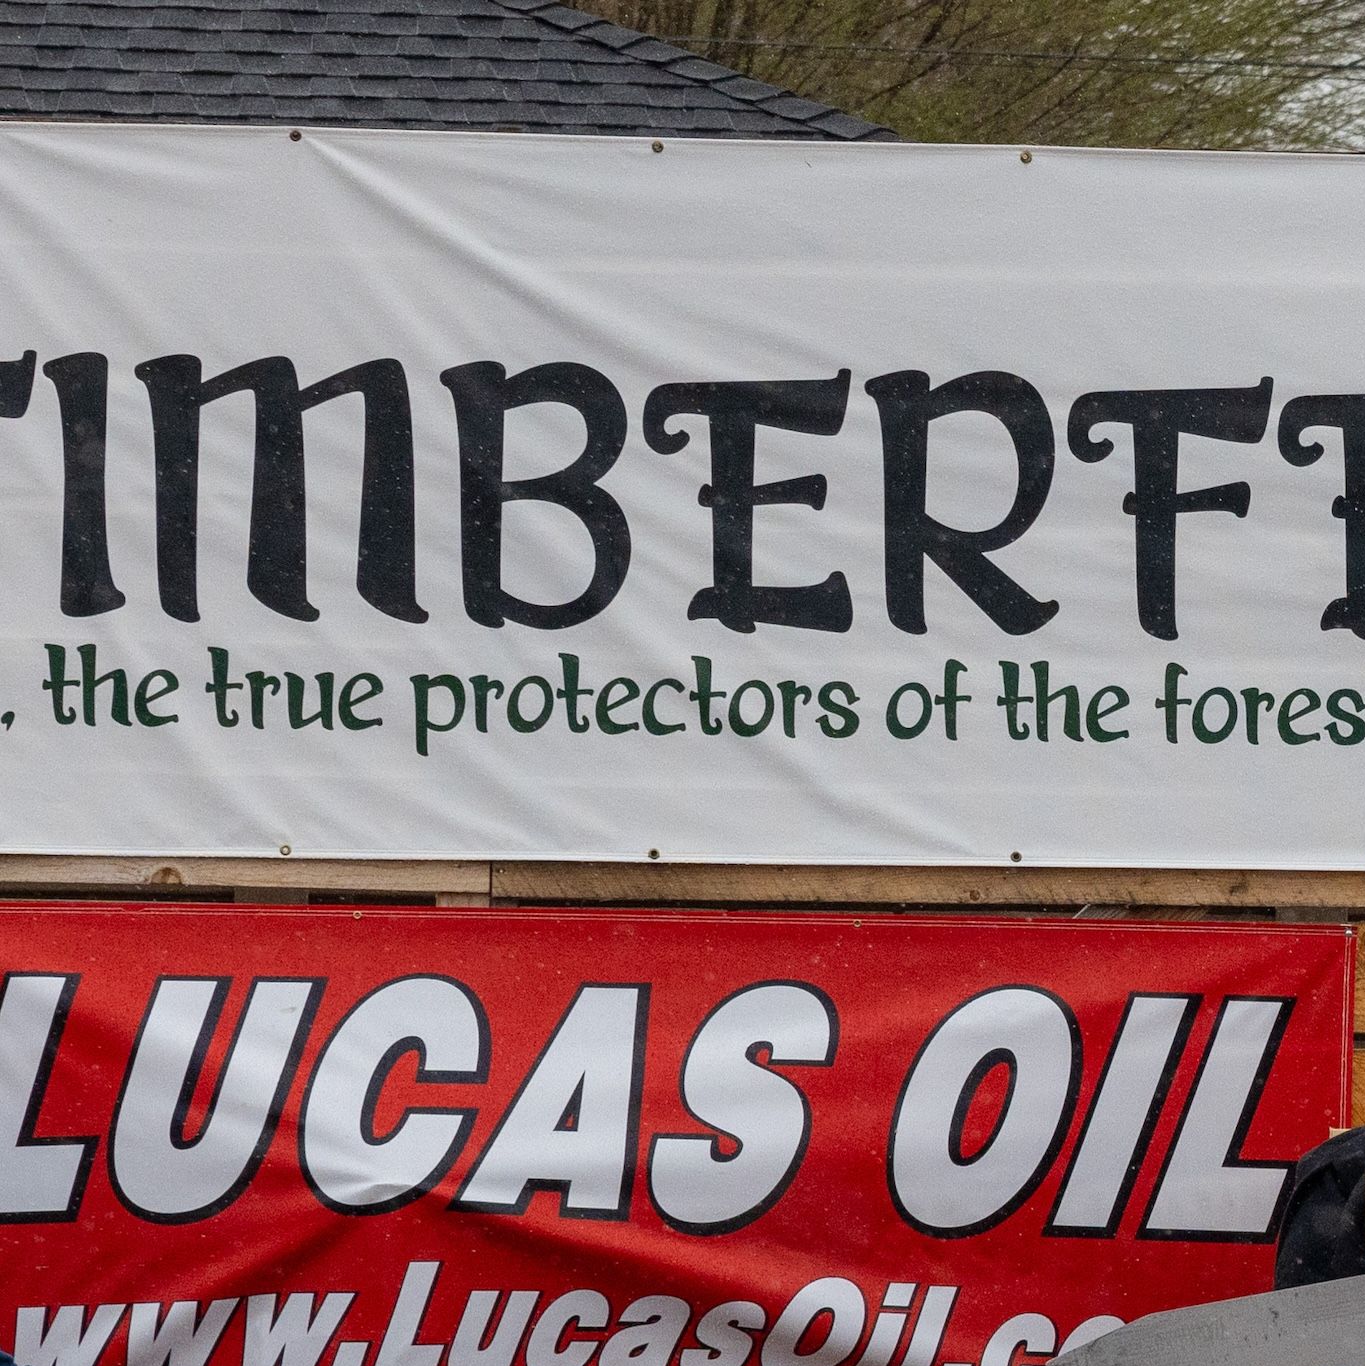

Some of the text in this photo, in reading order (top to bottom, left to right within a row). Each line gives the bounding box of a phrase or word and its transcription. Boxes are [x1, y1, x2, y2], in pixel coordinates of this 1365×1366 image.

[43, 642, 181, 727] the
[205, 645, 385, 731] true
[410, 652, 861, 757] protectors
[885, 658, 972, 742] of
[996, 660, 1130, 744] the
[0, 969, 840, 1236] LUCAS
[886, 982, 1298, 1244] OIL
